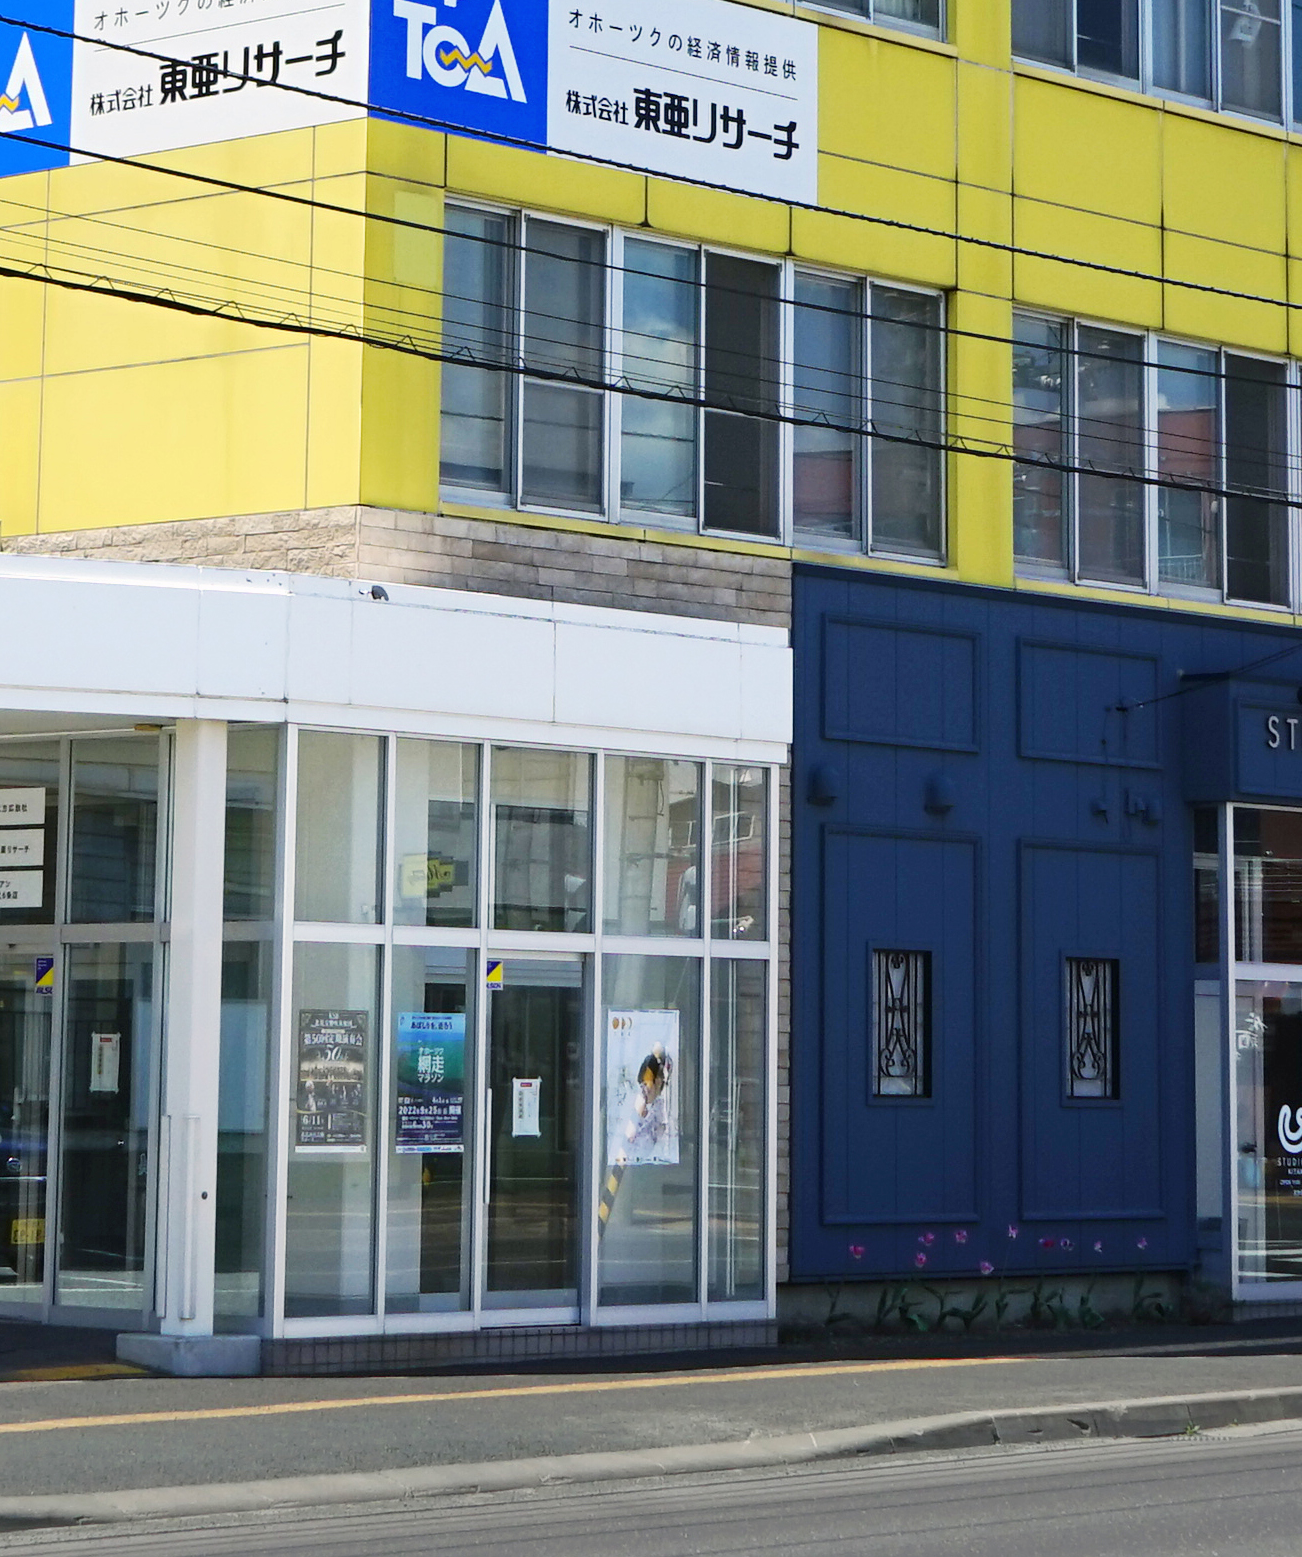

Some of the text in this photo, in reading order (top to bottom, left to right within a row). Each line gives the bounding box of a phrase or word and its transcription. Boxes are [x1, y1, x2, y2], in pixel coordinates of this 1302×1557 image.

[89, 28, 346, 116] 株式会社 東亜リサーチ
[569, 8, 797, 81] オホーツクの経済情報提供
[566, 87, 800, 161] 株式会社 東亜リサーチ
[418, 1055, 445, 1073] 網走
[418, 1073, 444, 1083] マラソン
